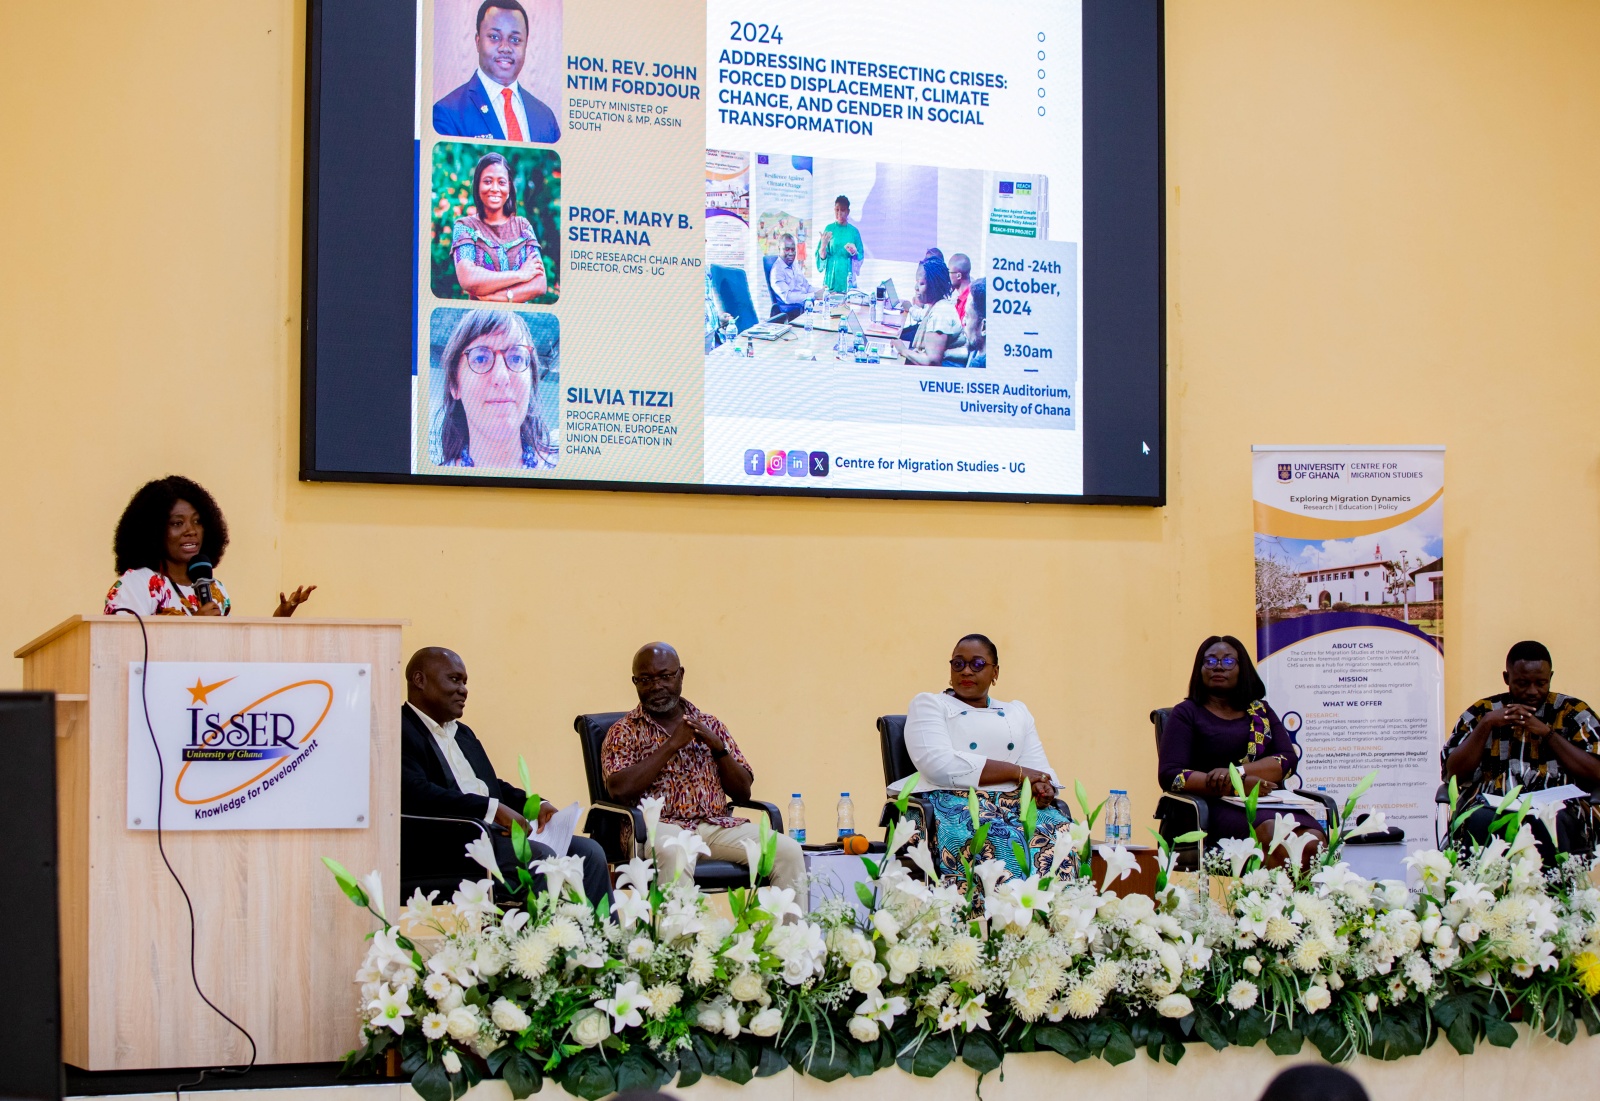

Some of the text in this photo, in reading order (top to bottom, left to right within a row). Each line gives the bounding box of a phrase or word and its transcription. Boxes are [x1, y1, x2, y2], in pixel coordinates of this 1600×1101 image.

[730, 21, 783, 44] 2024
[567, 56, 697, 80] HON. REV. JOHN
[719, 49, 1008, 89] ADDRESSING INTERSECTING CRISES:
[567, 75, 700, 99] NTIM FORDJOUR
[719, 69, 989, 106] FORCED DISPLACEMENT, CLIMATE
[570, 99, 668, 114] DEPUTY MINISTER OF
[719, 89, 984, 125] CHANGE, AND GENDER IN SOCIAL
[569, 121, 601, 131] SOUTH
[570, 110, 624, 123] EDUCATION
[627, 115, 633, 123] &
[654, 117, 681, 127] ASSIN
[718, 109, 873, 136] TRANSFORMATION
[569, 206, 618, 224] PROF.
[624, 210, 673, 228] MARY
[679, 215, 693, 229] B.
[569, 226, 651, 246] SETRANA
[571, 251, 701, 267] IDRC RESEARCH CHAIR AND
[992, 258, 1061, 274] 22nd -24th
[623, 265, 643, 274] CMS
[651, 267, 664, 276] UG
[993, 277, 1060, 297] October,
[993, 299, 1031, 315] 2024
[1004, 344, 1052, 358] 9:30am
[567, 387, 673, 407] SILVIA TIZZI
[920, 381, 1071, 399] VENUE: ISSER Auditorium,
[567, 411, 671, 423] PROGRAMME OFFICER
[960, 402, 1071, 416] University of Ghana
[626, 425, 677, 434] EUROPEAN
[566, 434, 672, 446] UNION DELEGATION IN
[566, 446, 601, 455] GHANA
[835, 457, 874, 469] Centre
[878, 458, 894, 470] for
[898, 459, 953, 473] Migration
[957, 460, 999, 472] Studies
[1009, 462, 1025, 473] UG
[186, 708, 299, 750] ISSER
[186, 750, 263, 760] University of Ghana
[195, 739, 318, 819] Knowledge for Development
